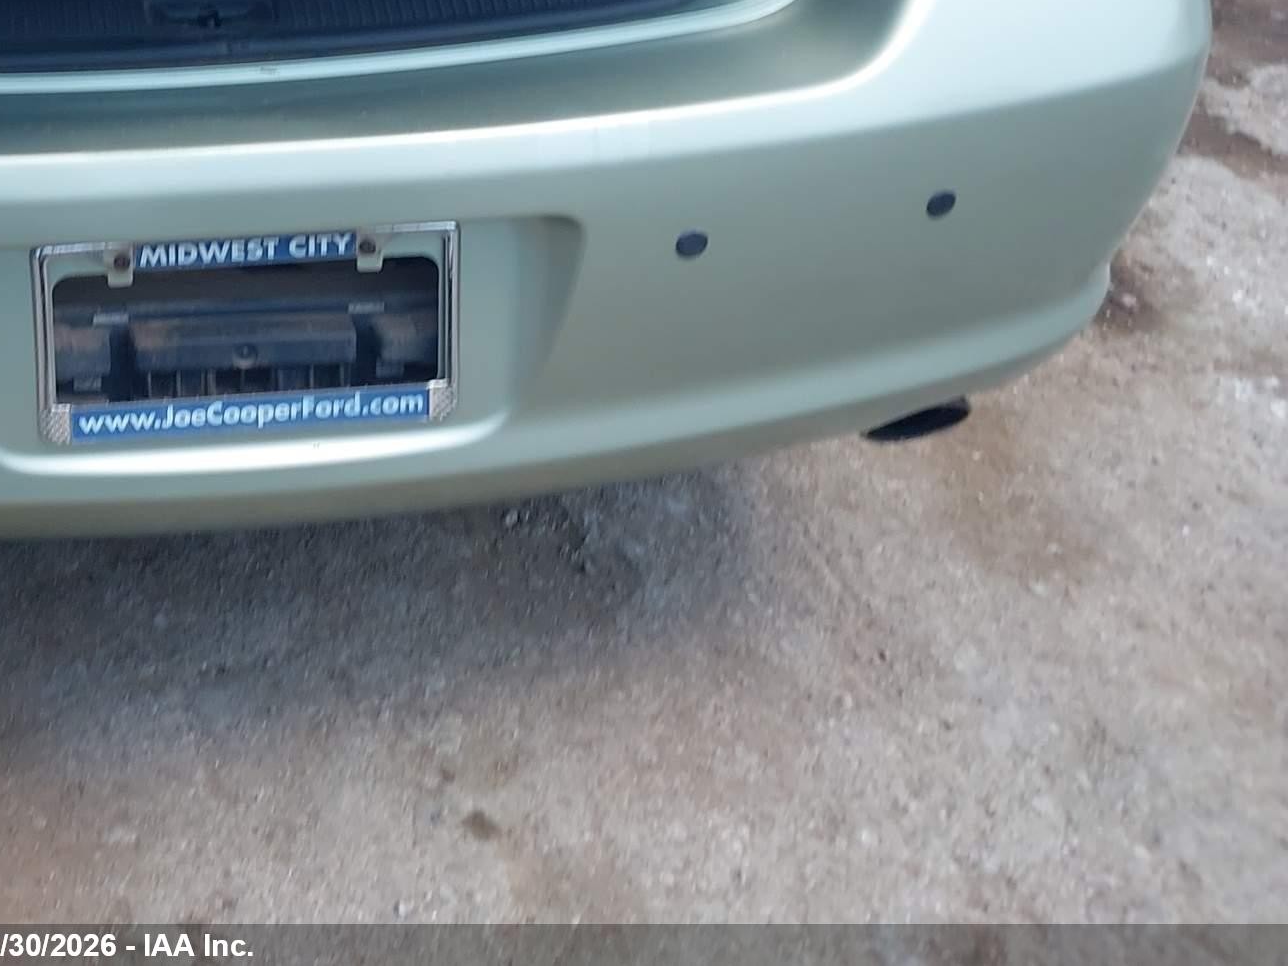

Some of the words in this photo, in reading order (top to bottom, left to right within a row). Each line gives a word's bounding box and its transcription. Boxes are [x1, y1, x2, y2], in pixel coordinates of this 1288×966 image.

[139, 237, 279, 268] MIDWEST
[289, 233, 354, 258] CITY
[78, 392, 424, 434] www.JoeCooperFord.com
